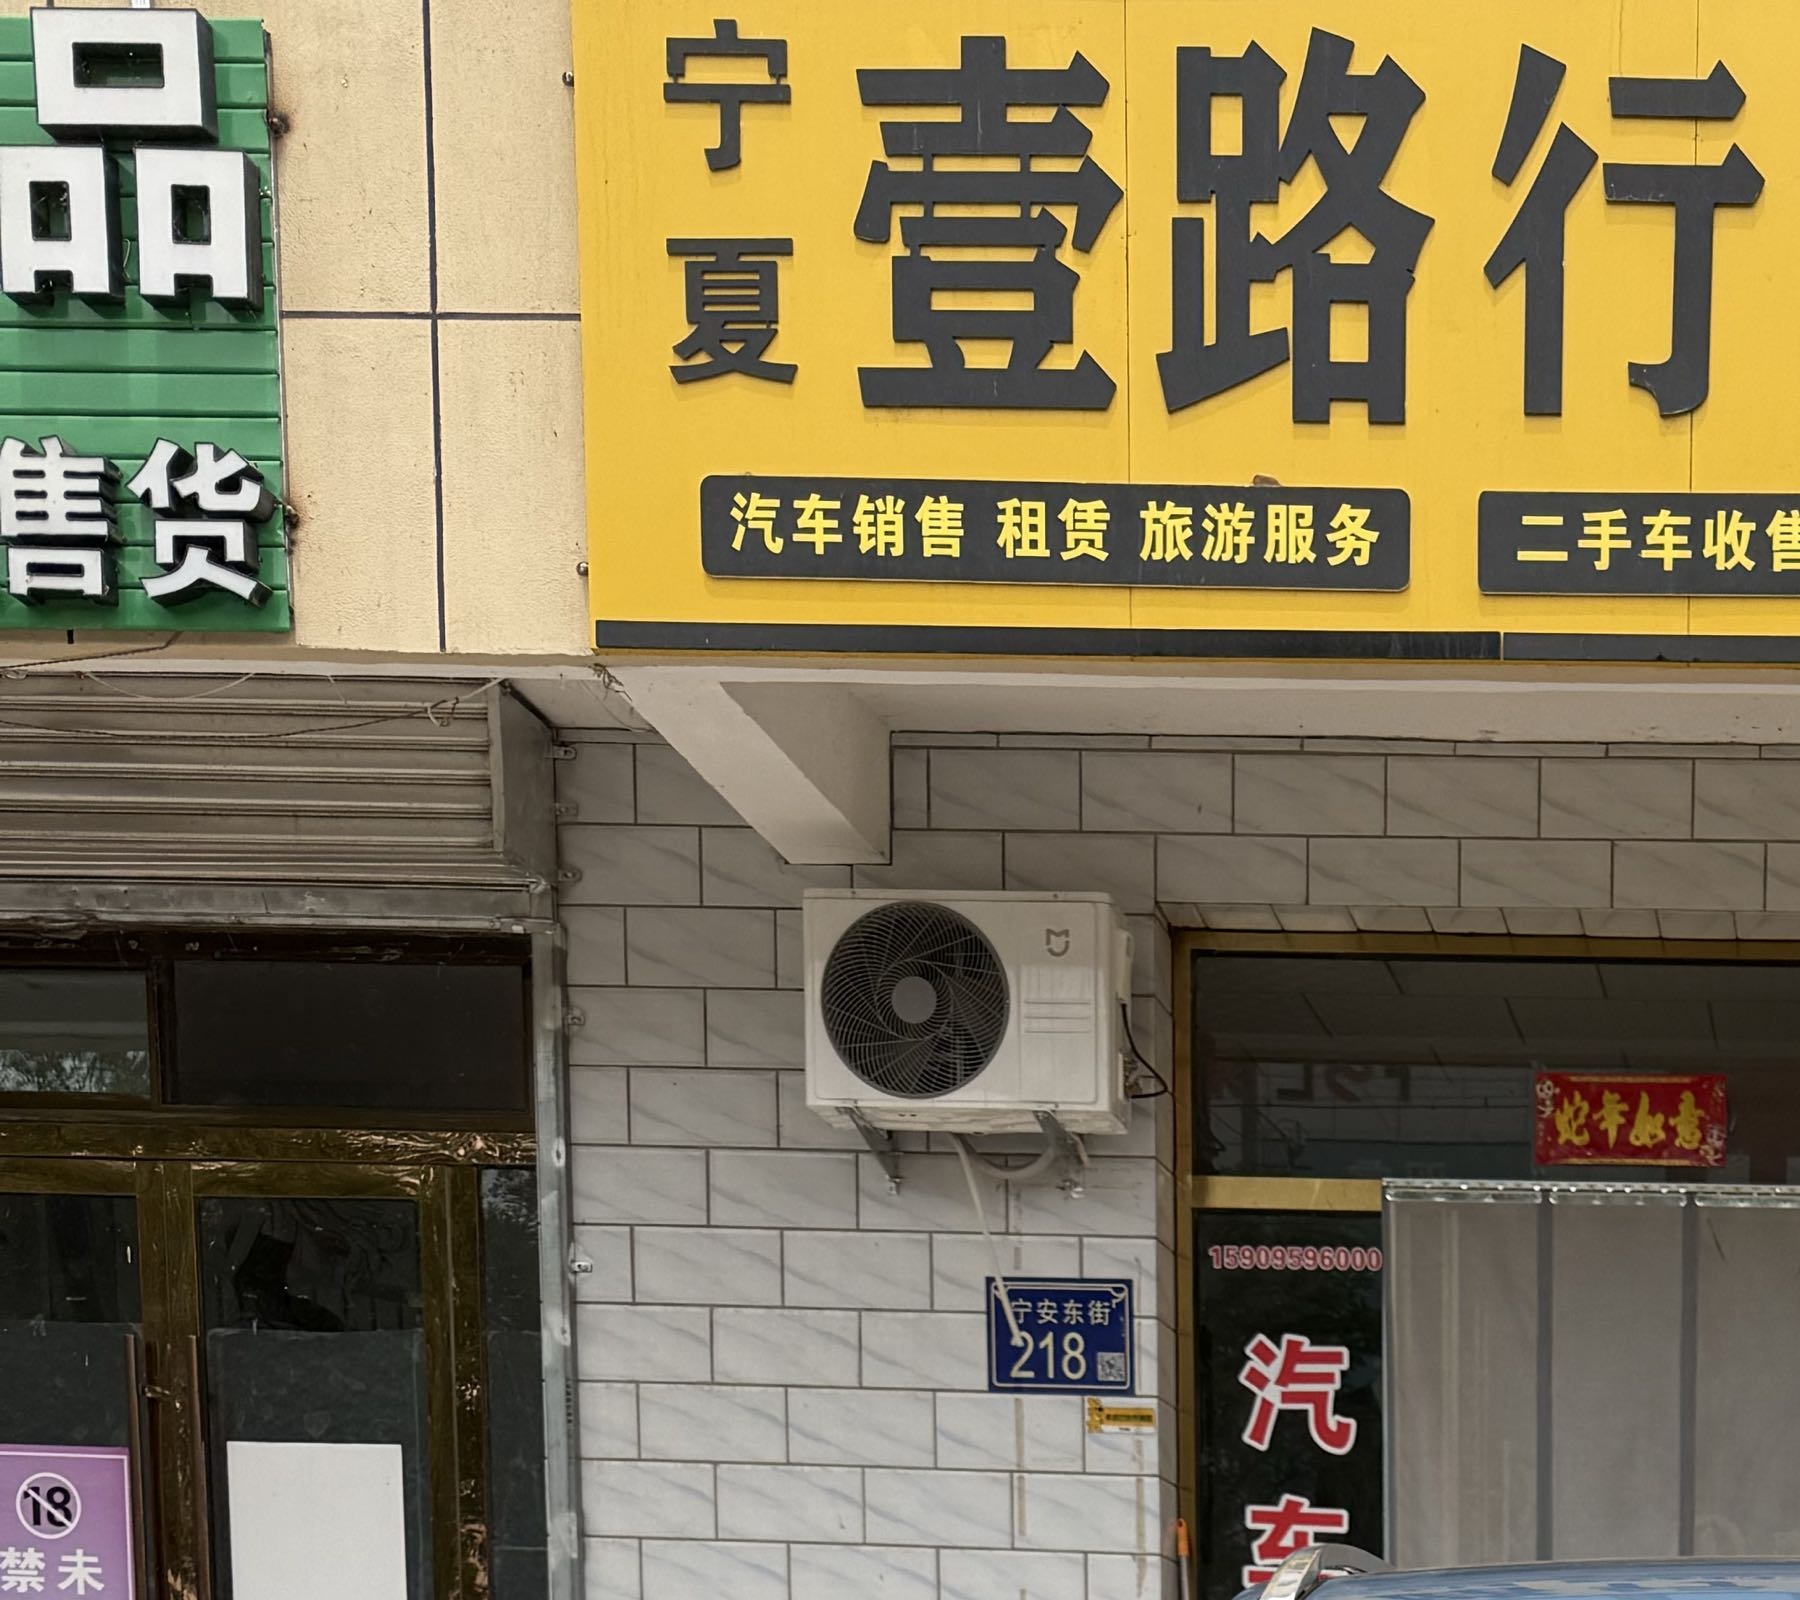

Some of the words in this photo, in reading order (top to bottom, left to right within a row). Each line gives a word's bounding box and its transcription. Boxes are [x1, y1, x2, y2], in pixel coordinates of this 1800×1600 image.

[0, 8, 262, 306] 品
[664, 19, 798, 384] 宁夏
[0, 435, 272, 606] 售货
[731, 492, 966, 559] 汽车销售
[997, 498, 1111, 561] 租赁
[1140, 501, 1381, 567] 旅游服务
[1208, 1245, 1384, 1272] 15909596000
[1010, 1298, 1111, 1326] 宁安东街
[1009, 1331, 1087, 1380] 218
